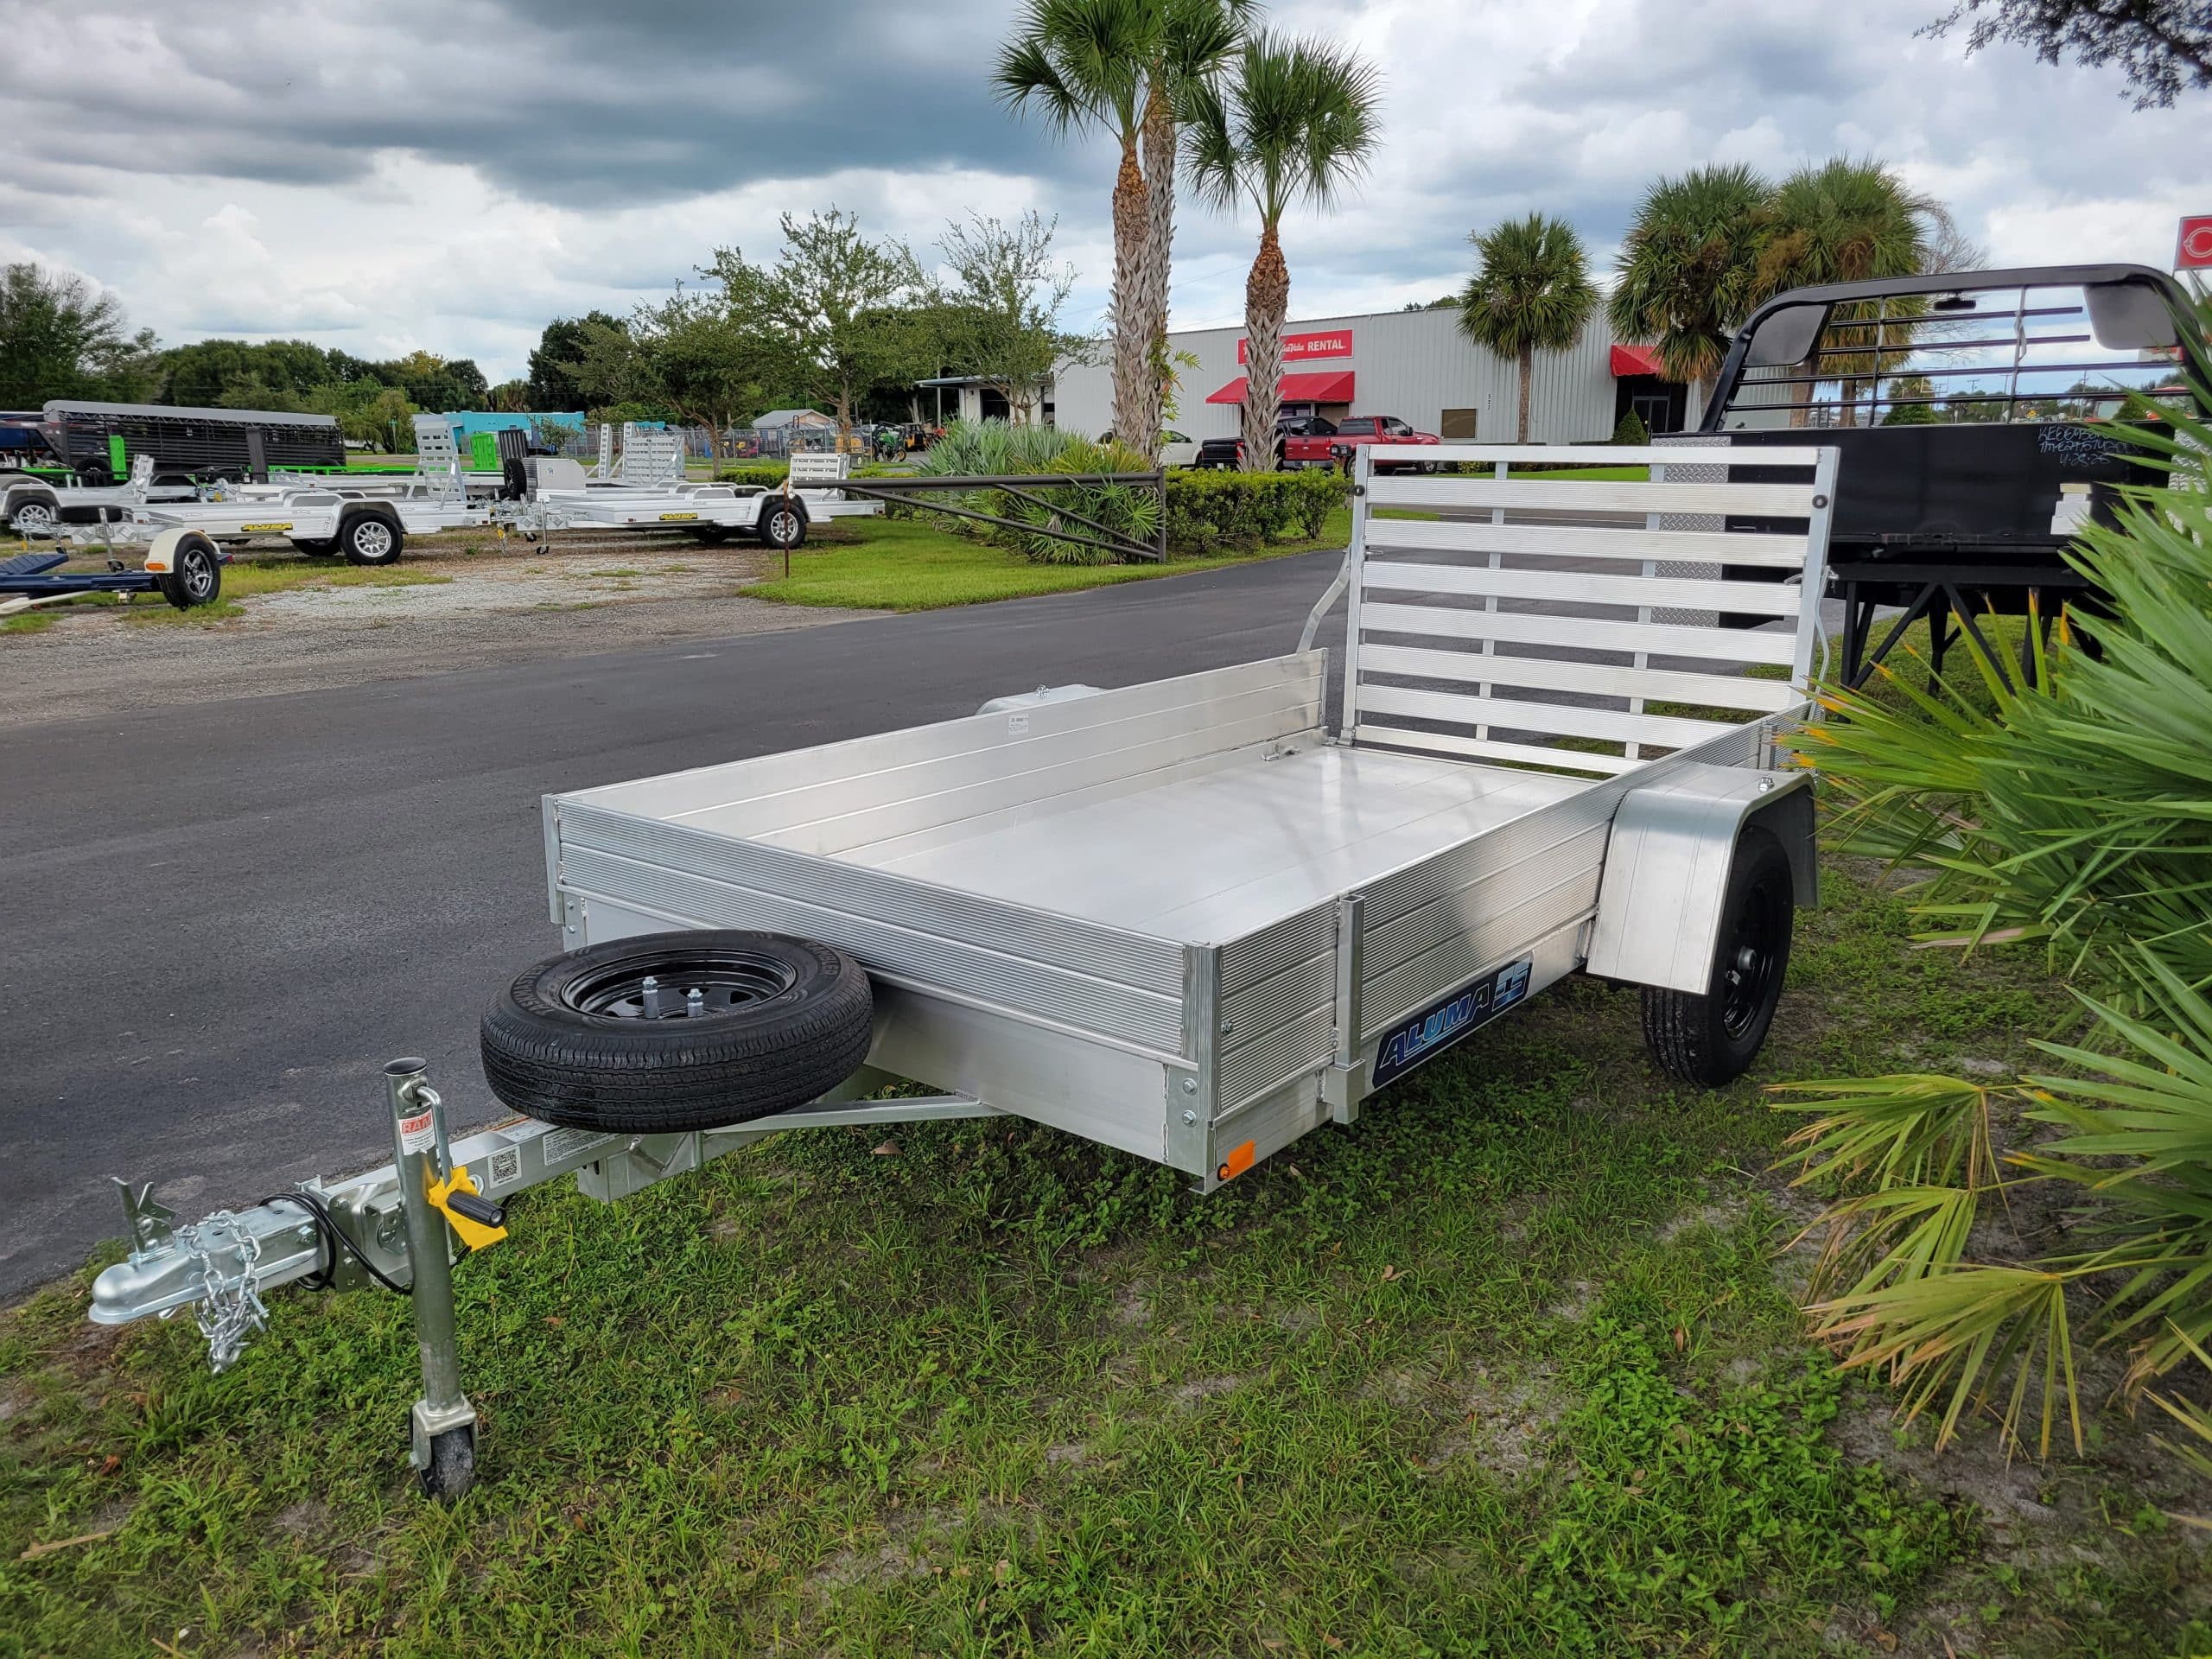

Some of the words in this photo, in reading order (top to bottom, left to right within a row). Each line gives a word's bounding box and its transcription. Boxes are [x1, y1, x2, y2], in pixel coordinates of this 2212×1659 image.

[1307, 339, 1344, 352] RENTAL
[241, 523, 293, 531] ALUMA
[802, 941, 838, 976] RAMBLER
[512, 964, 552, 1016] TASKMASTER
[1378, 982, 1490, 1069] ALUMA
[401, 1112, 432, 1134] RAM
